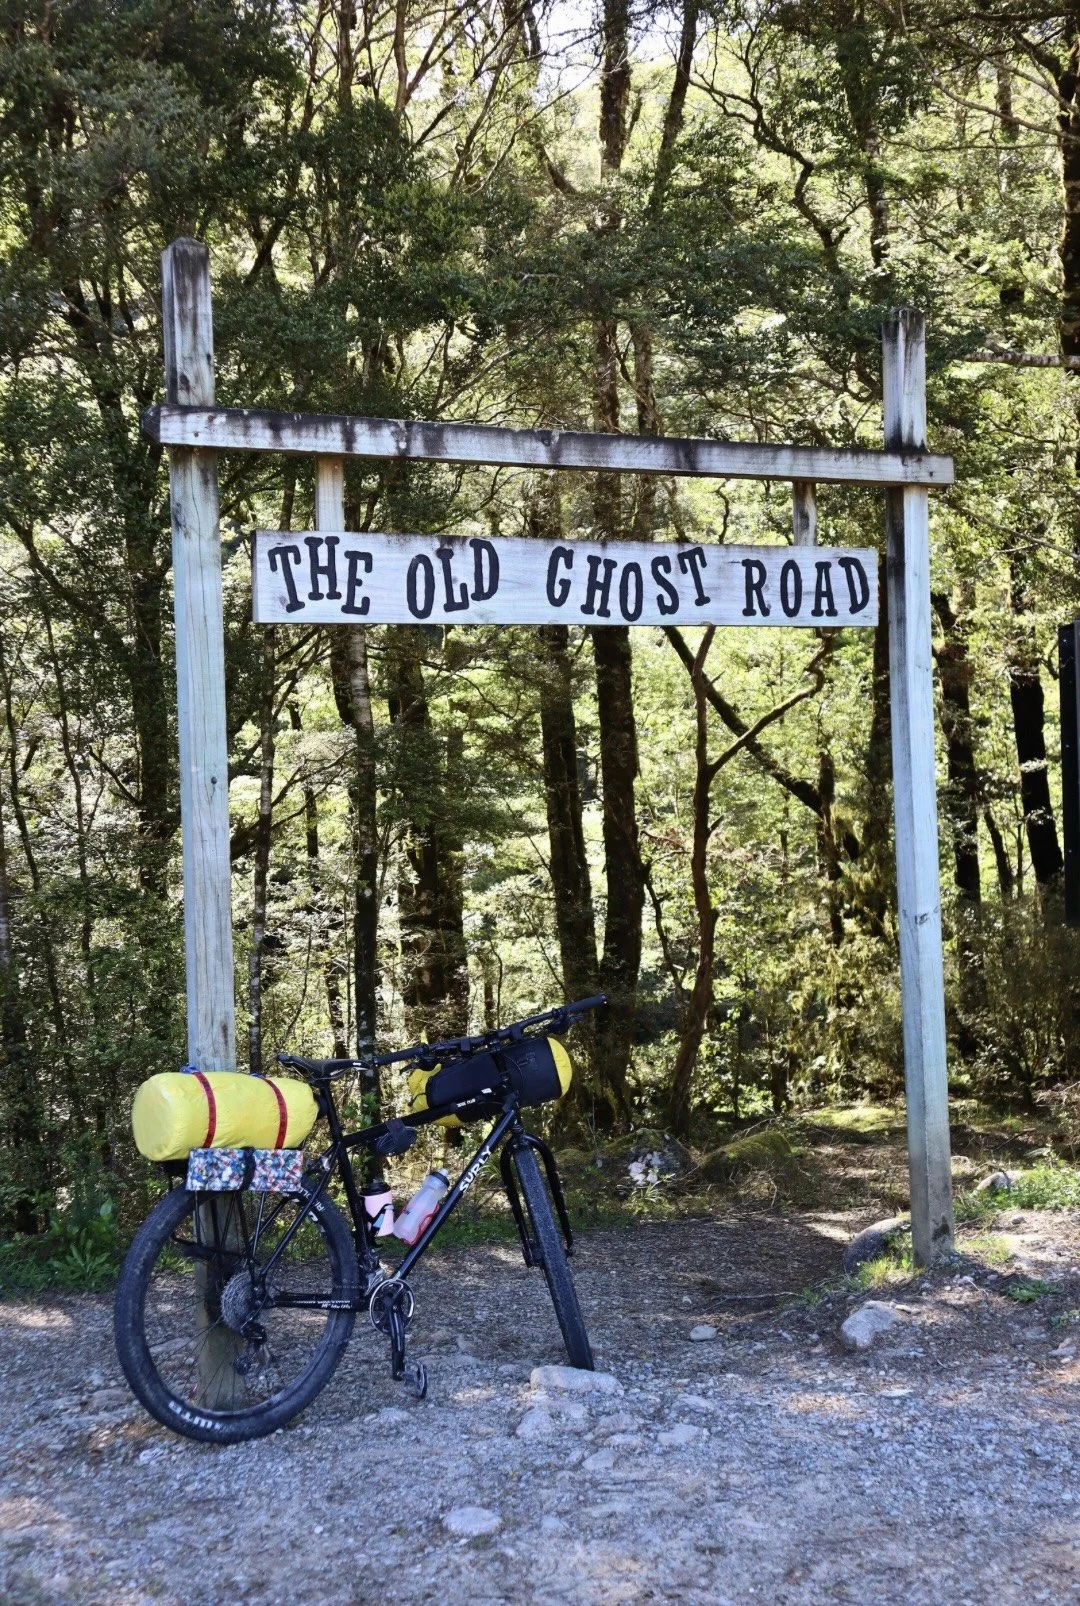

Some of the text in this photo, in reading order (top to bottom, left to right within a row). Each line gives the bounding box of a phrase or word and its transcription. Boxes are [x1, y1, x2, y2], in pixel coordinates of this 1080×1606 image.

[267, 536, 870, 622] THE OLD GHOST ROAD
[460, 1145, 491, 1193] SURLY
